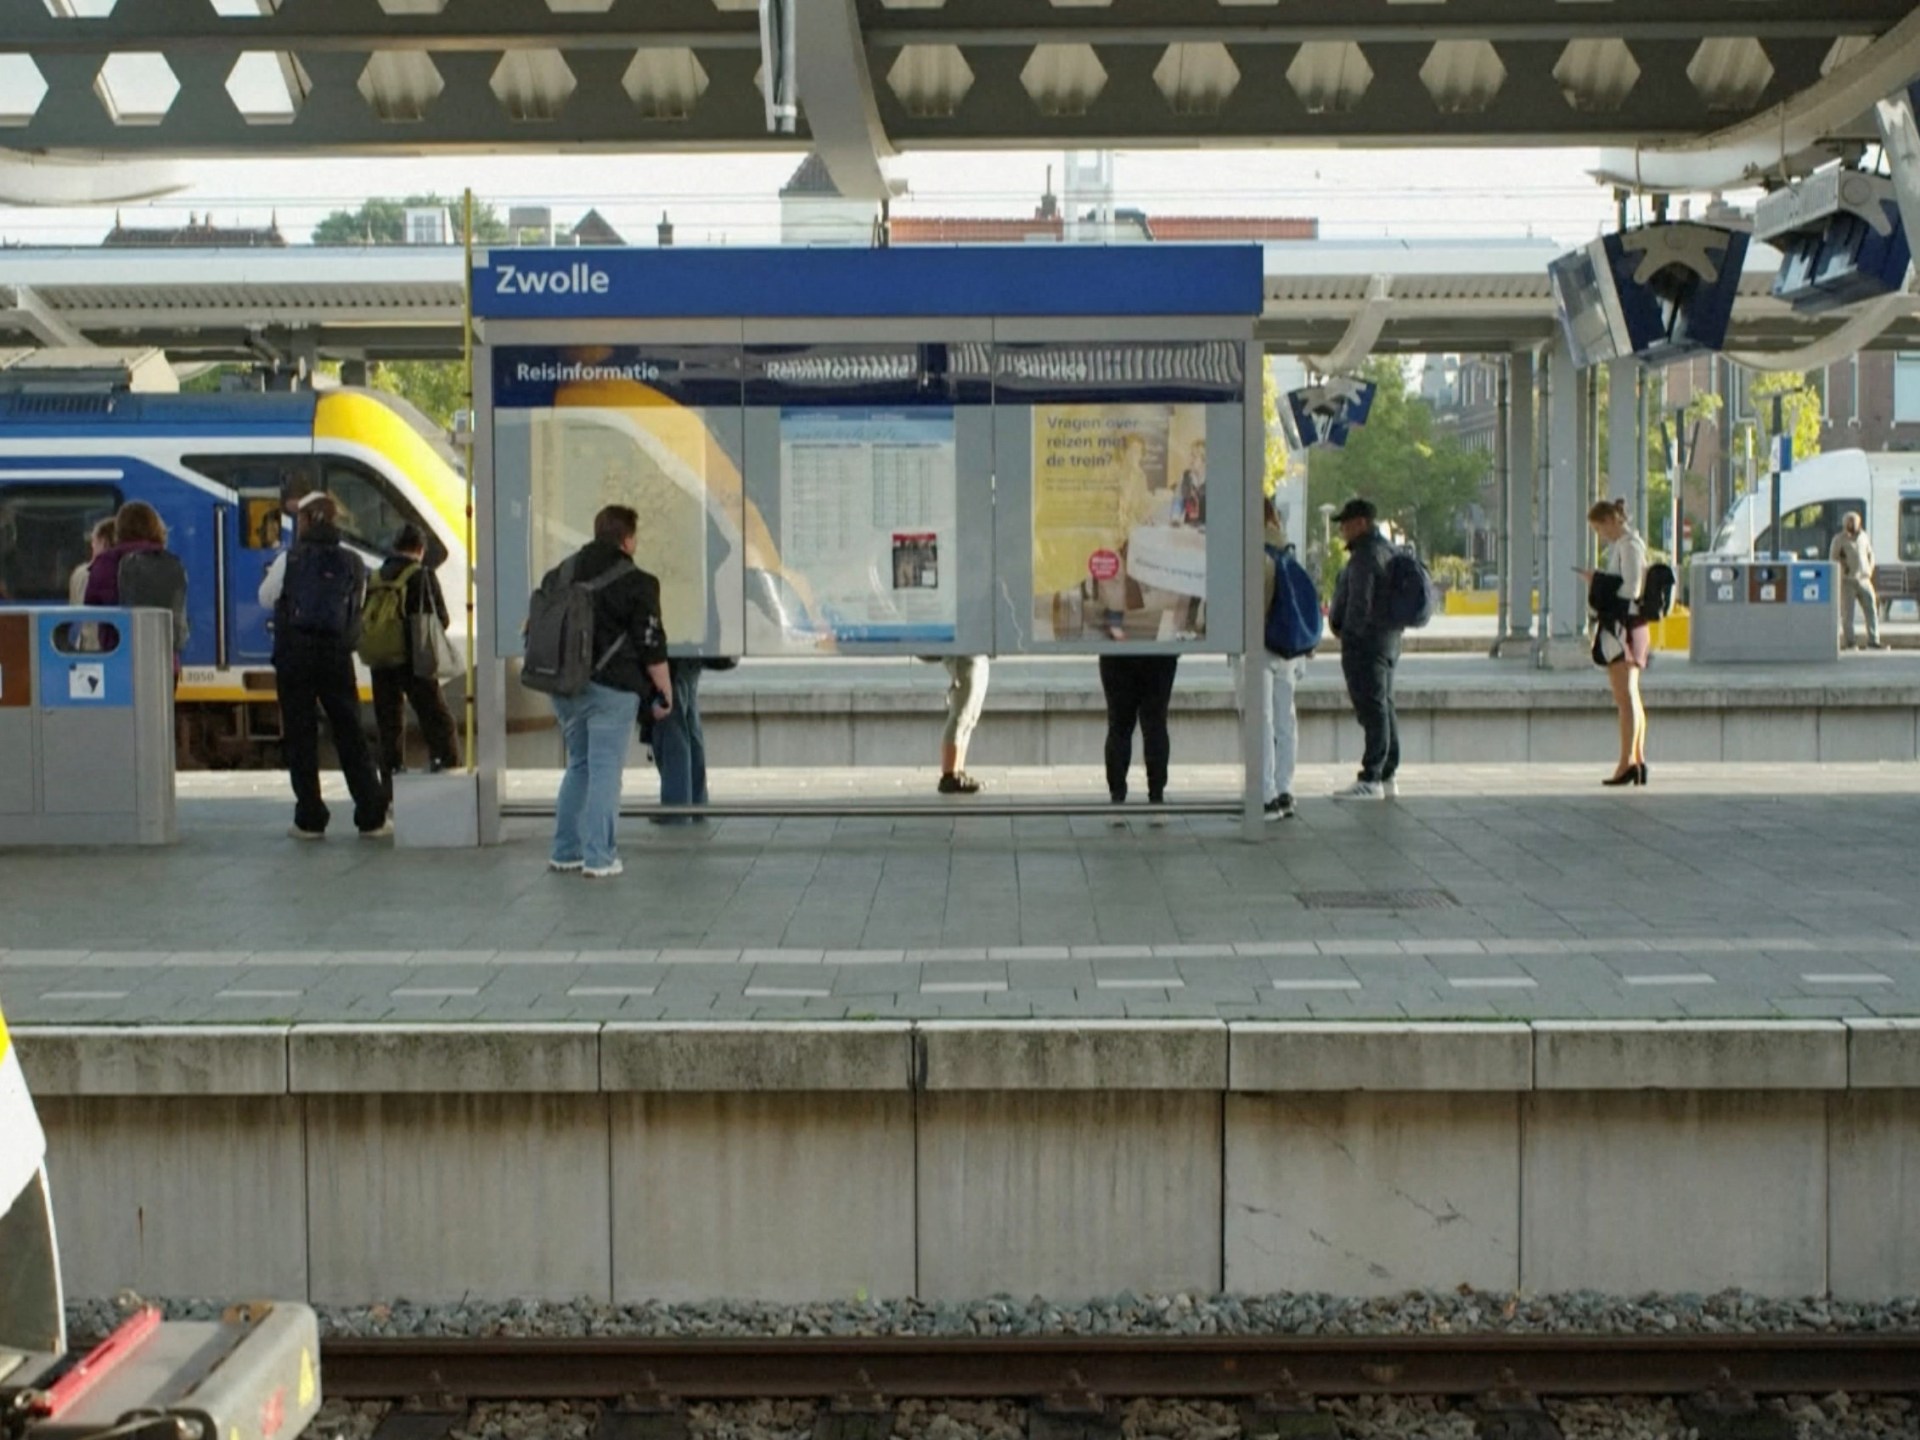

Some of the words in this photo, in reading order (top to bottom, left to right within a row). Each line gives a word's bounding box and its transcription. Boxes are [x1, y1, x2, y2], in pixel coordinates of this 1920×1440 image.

[495, 263, 610, 294] Zwolle
[516, 362, 660, 382] Reisinformatie
[1047, 416, 1101, 432] Vragen
[1106, 418, 1138, 429] over
[1047, 433, 1092, 448] reizen
[1046, 452, 1065, 467] de
[1070, 453, 1112, 467] trein?
